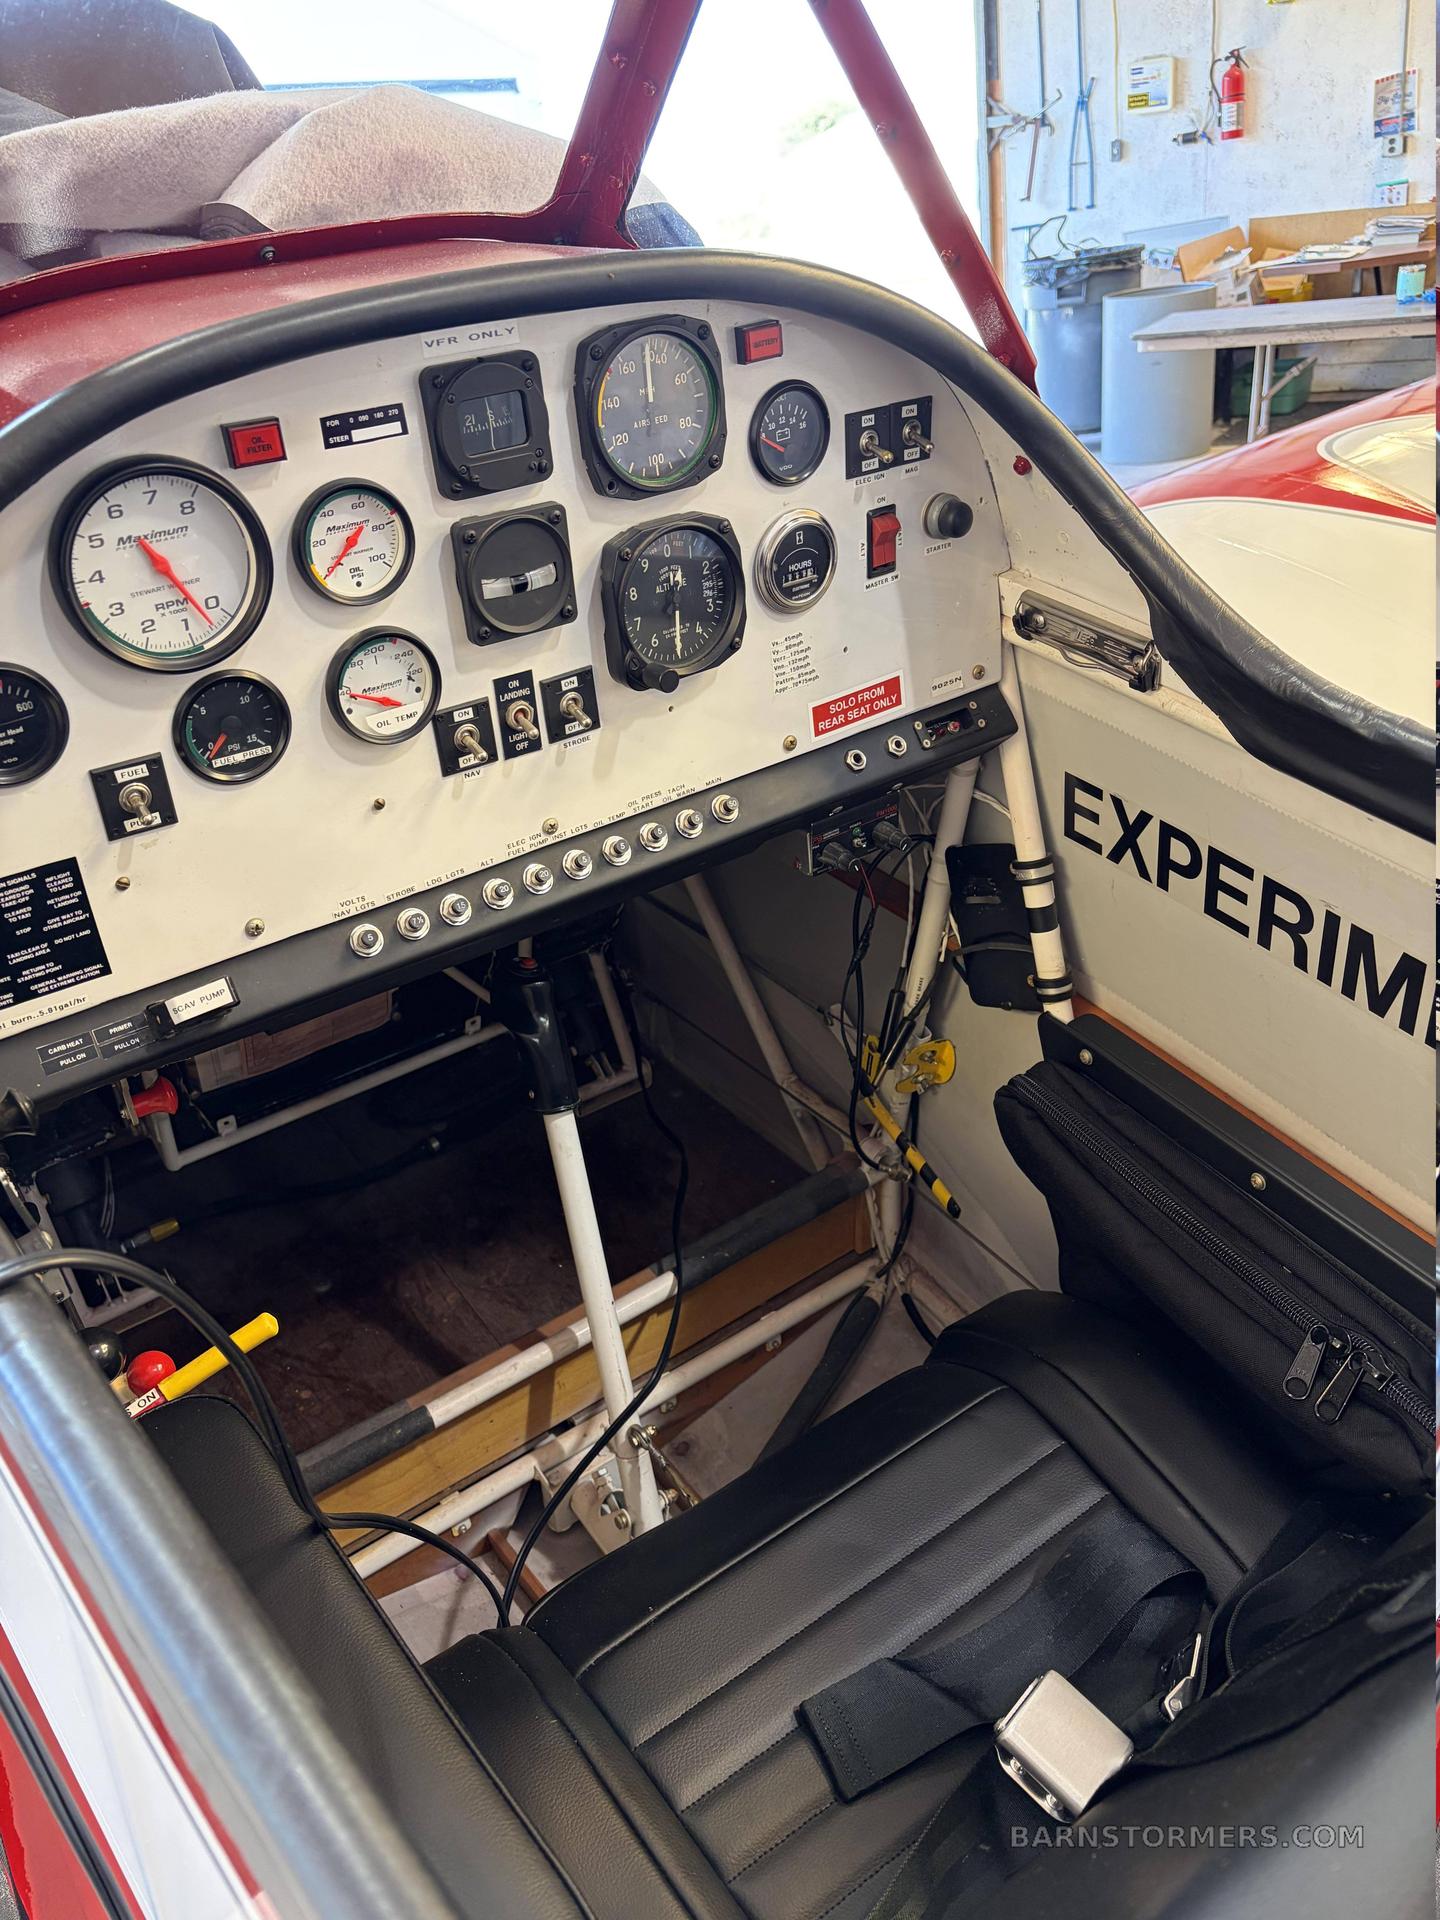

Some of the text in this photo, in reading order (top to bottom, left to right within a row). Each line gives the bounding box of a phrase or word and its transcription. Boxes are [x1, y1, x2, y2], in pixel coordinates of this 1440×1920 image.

[424, 327, 516, 348] VFR ONLY
[656, 353, 667, 365] 40
[618, 361, 636, 374] 160
[675, 372, 687, 385] 60
[603, 397, 620, 410] 140
[326, 419, 340, 428] FOR
[634, 416, 668, 429] AIRSEED
[680, 417, 692, 428] 80
[779, 416, 786, 424] 12
[800, 422, 807, 430] 16
[864, 416, 873, 424] ON
[768, 423, 776, 431] 10
[329, 434, 349, 444] STEER
[612, 433, 629, 446] 120
[649, 454, 665, 467] 100
[907, 450, 919, 458] OFF
[779, 464, 793, 472] VDO
[864, 460, 877, 469] OFF
[905, 466, 919, 474] MAG
[855, 473, 885, 486] ELEC IGN
[143, 490, 158, 505] 7
[877, 496, 886, 504] ON
[108, 504, 124, 519] 6
[180, 500, 196, 516] 8
[351, 501, 366, 510] 60
[320, 510, 335, 518] 40
[326, 519, 370, 533] Maximum
[372, 524, 385, 532] 80
[88, 533, 105, 549] 5
[116, 525, 189, 547] Maximum
[312, 539, 327, 548] 20
[926, 543, 952, 554] STARTER
[664, 544, 671, 558] 0
[368, 553, 386, 563] 100
[641, 559, 649, 573] 9
[702, 561, 710, 575] 2
[789, 560, 812, 572] HOURS
[87, 570, 106, 585] 4
[866, 574, 899, 590] MASTER SW
[130, 586, 166, 599] STEWART
[630, 588, 638, 601] 8
[155, 598, 189, 612] RPM
[205, 595, 221, 610] 0
[707, 599, 714, 612] 3
[109, 602, 125, 618] 3
[168, 608, 188, 616] 1000
[141, 620, 157, 634] 2
[181, 618, 190, 632] 1
[634, 617, 641, 631] 7
[696, 622, 703, 634] 4
[651, 634, 659, 647] 6
[364, 644, 385, 657] 200
[394, 650, 414, 660] 240
[362, 679, 403, 695] Maximum
[508, 680, 520, 689] ON
[564, 680, 575, 688] ON
[932, 676, 962, 691] 9025N
[240, 695, 250, 705] 10
[500, 688, 531, 702] LANDING
[830, 686, 885, 714] SOLO FROM
[16, 701, 34, 712] 600
[201, 706, 206, 716] 5
[818, 694, 898, 732] REAR SEAT ONLY
[376, 712, 418, 729] OIL TEMP
[458, 710, 470, 718] ON
[7, 726, 24, 736] Head
[247, 734, 258, 744] 15
[563, 735, 592, 749] STROBE
[208, 742, 214, 750] 0
[228, 744, 241, 752] PSI
[515, 741, 529, 751] OFF
[214, 747, 271, 767] FUEL PRESS
[120, 767, 147, 780] FUEL
[464, 769, 481, 779] NAV
[706, 777, 722, 787] MAIN
[627, 784, 686, 808] OIL PRESS TACH
[632, 788, 696, 813] START OIL WARN
[507, 812, 626, 857] FUEL PUMP INST LGTS OIL TEMP
[507, 833, 542, 850] ELEC IGN
[620, 842, 626, 850] 5
[480, 858, 495, 868] ALT
[426, 868, 465, 887] LDG LGTS
[540, 870, 549, 878] 20
[386, 886, 416, 902] STROBE
[499, 885, 509, 893] 20
[339, 895, 366, 908] VOLTS
[456, 902, 466, 910] 15
[4, 907, 32, 919] CLEARED
[334, 901, 376, 919] NAV LGTS
[43, 913, 90, 932] OTHER AIRCRAFT
[16, 927, 32, 936] STOP
[76, 929, 91, 938] LAND
[367, 934, 374, 942] 5
[8, 948, 51, 965] LANDING AREA
[21, 946, 40, 956] CLEAR
[45, 965, 63, 974] POINT
[30, 963, 104, 991] GENERAL WARNING SIGNAL
[50, 978, 75, 990] EXTREME
[76, 970, 100, 983] CAUTION
[172, 989, 226, 1015] SCAV PUMP
[109, 1022, 133, 1035] PRIMER
[48, 1038, 84, 1055] CARB HEAT
[114, 1041, 130, 1051] PULL
[60, 1052, 87, 1067] PULL ON
[137, 1392, 156, 1409] ON
